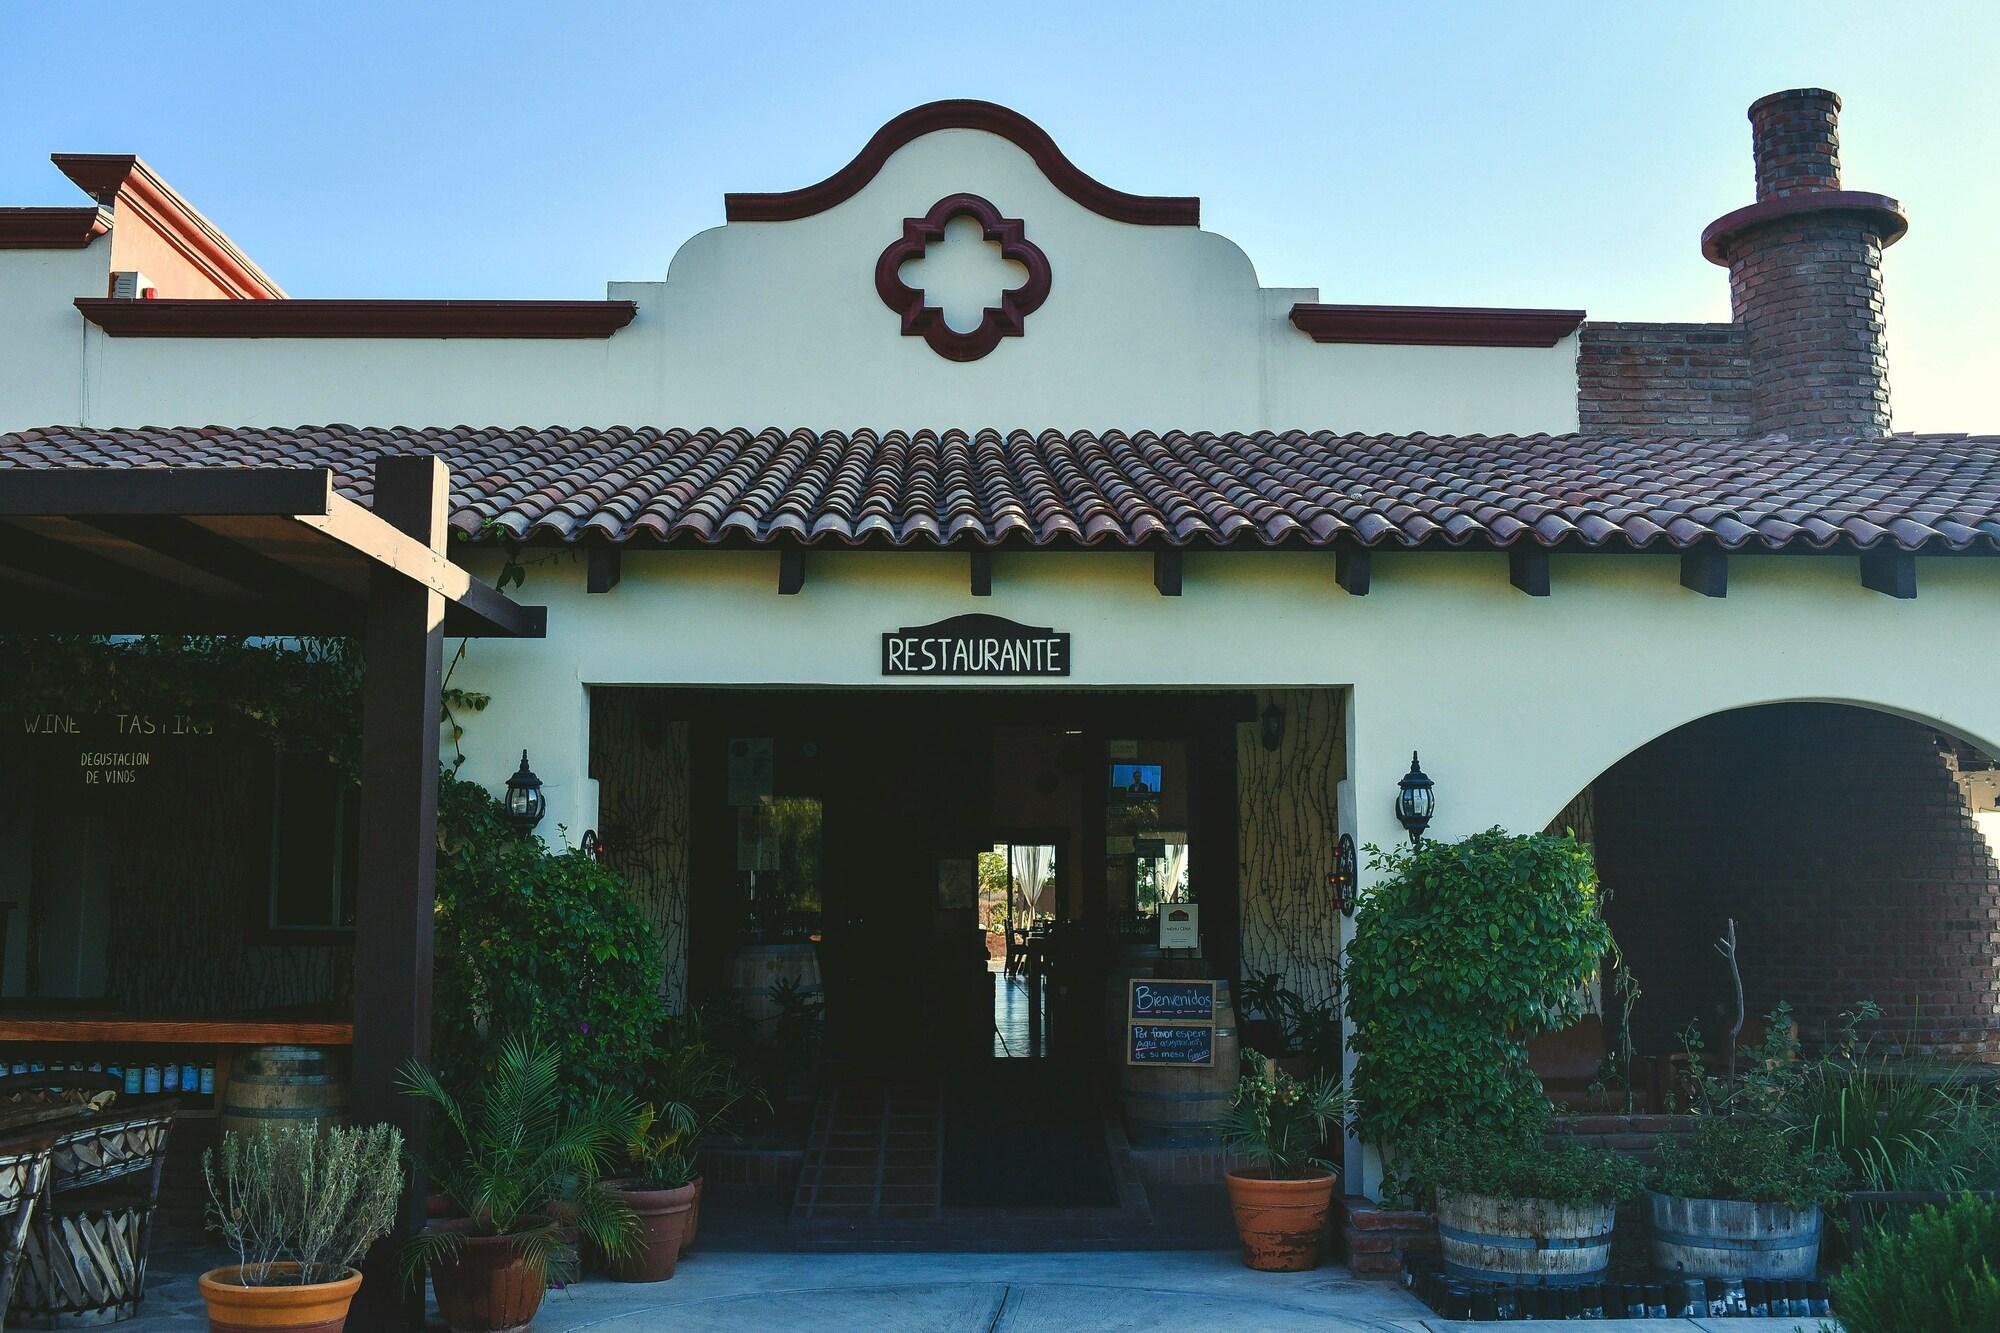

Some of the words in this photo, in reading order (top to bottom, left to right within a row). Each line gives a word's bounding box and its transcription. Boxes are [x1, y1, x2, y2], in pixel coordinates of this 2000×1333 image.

[888, 637, 1062, 672] RESTAURANTE
[24, 713, 81, 734] WINE
[80, 752, 150, 767] DEGUSTACION
[86, 770, 100, 784] DE
[105, 769, 136, 784] VINOS
[1135, 985, 1212, 1010] Bienvenidos
[1134, 1026, 1148, 1039] Por
[1151, 1026, 1174, 1039] favor
[1175, 1029, 1208, 1041] espere
[1135, 1050, 1146, 1060] de
[1149, 1051, 1159, 1059] su
